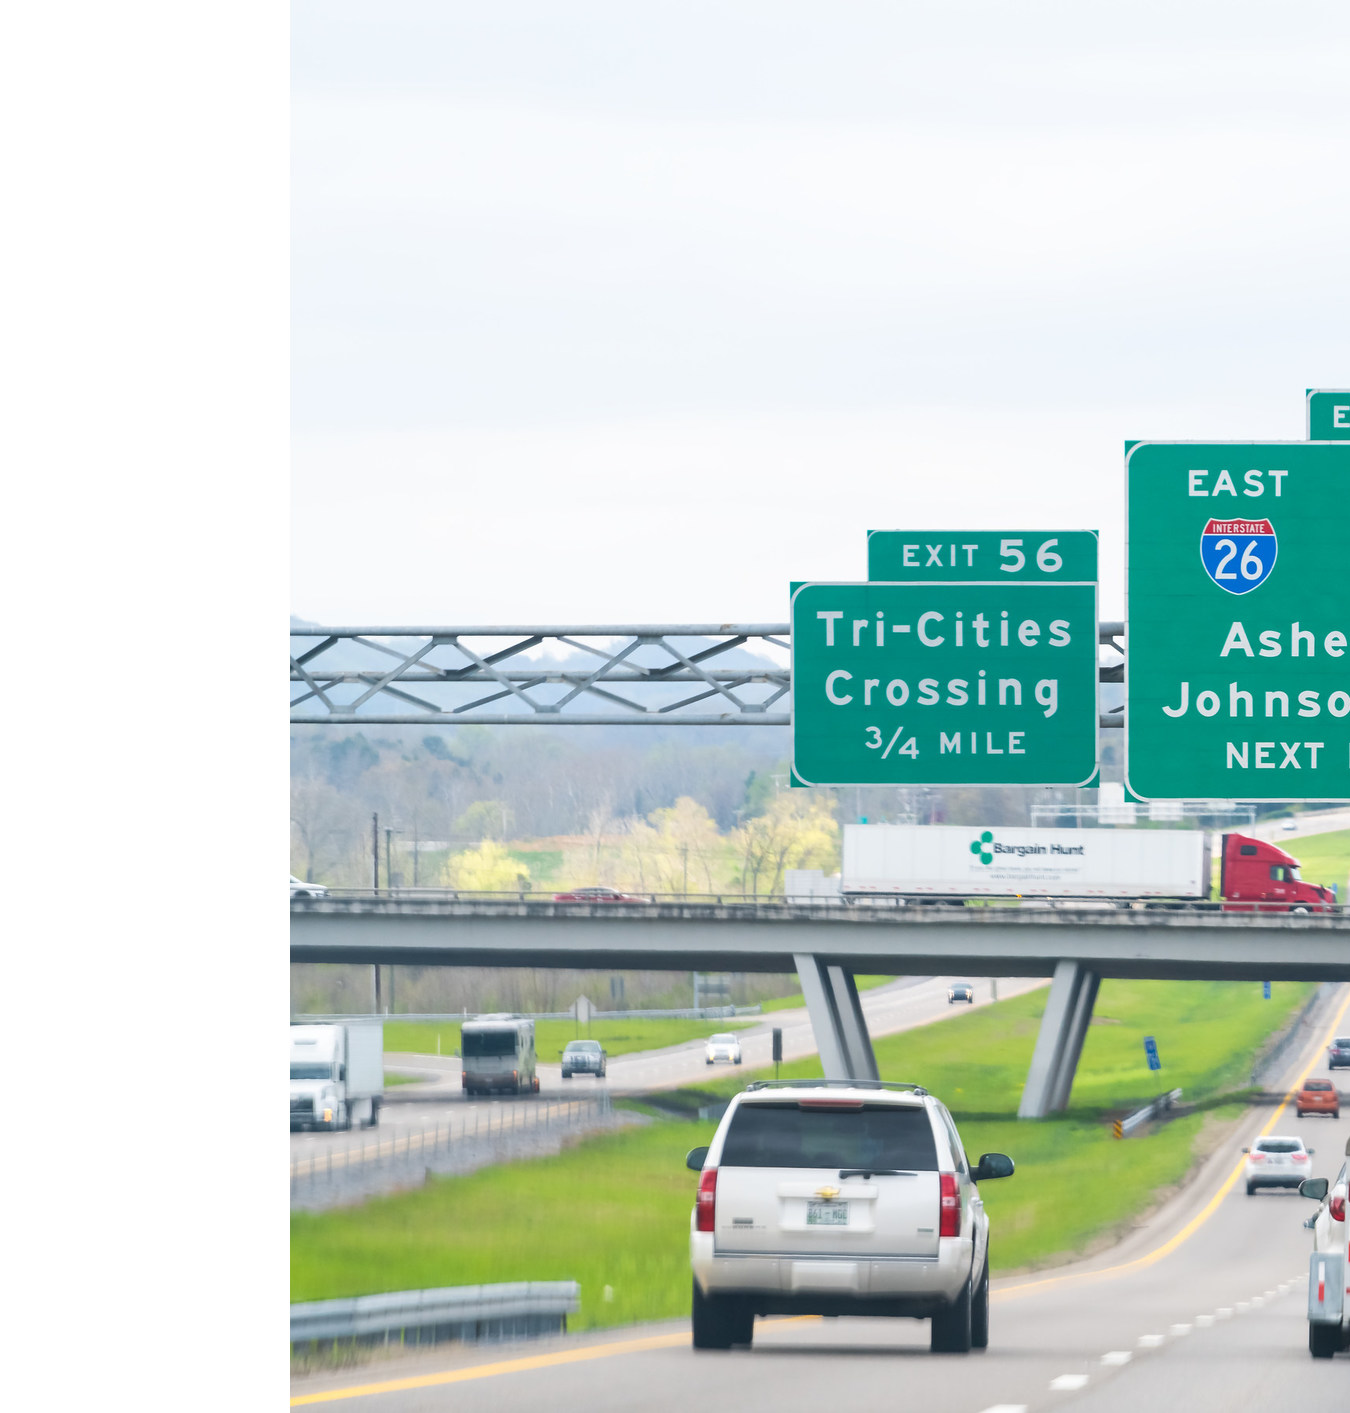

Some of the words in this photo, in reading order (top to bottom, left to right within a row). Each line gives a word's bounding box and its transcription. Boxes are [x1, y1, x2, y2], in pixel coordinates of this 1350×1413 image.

[1188, 469, 1289, 497] EAST
[1212, 523, 1265, 534] INTERSTATE
[902, 544, 979, 567] EXIT
[999, 538, 1063, 573] 56
[1214, 538, 1263, 580] 26
[816, 610, 1071, 648] Tri-Cities
[825, 669, 1058, 719] Crossing
[865, 726, 920, 760] 3/4
[940, 731, 1026, 754] MILE
[1225, 741, 1324, 769] NEXT
[993, 843, 1047, 857] Bargain
[1050, 844, 1085, 856] Hunt
